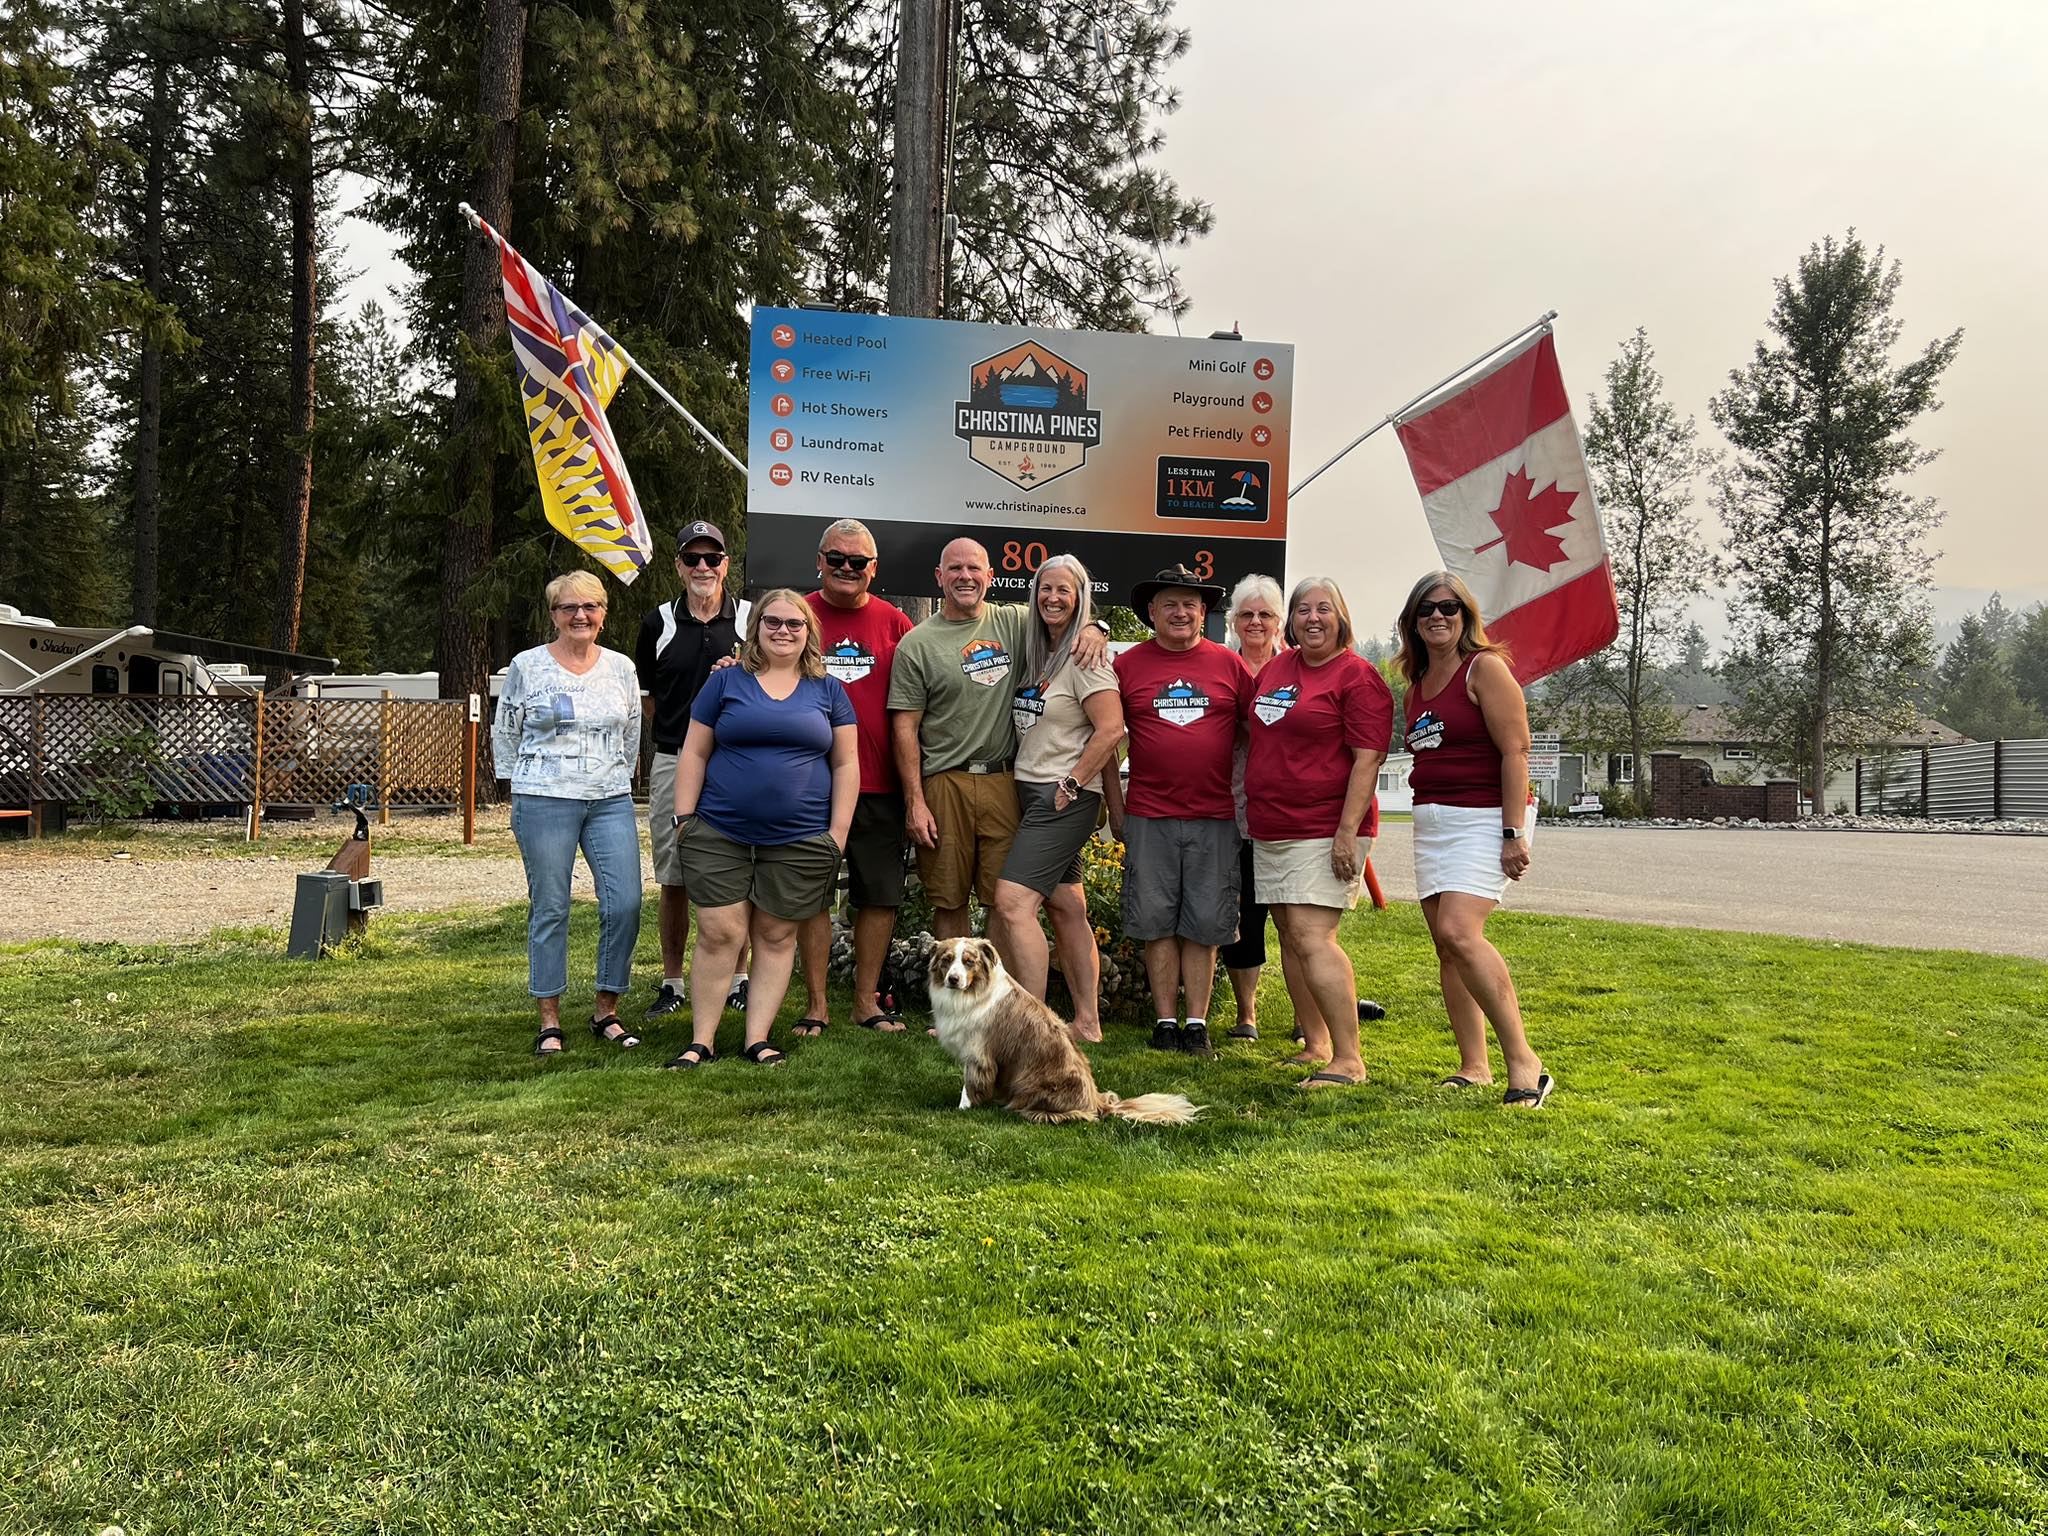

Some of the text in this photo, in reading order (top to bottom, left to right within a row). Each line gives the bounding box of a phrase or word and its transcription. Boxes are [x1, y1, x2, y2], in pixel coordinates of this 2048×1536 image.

[803, 331, 887, 350] Heated Pool
[1189, 359, 1247, 374] Mini Golf
[802, 367, 871, 383] Free Wi-Fi
[1173, 392, 1245, 408] Playground
[802, 402, 888, 419] Hot Showers
[958, 409, 1097, 438] CHRISTINA PINES
[1168, 425, 1243, 443] Pet Friendly
[801, 435, 884, 453] Laundromat
[989, 440, 1066, 455] CAMPGROUND
[800, 471, 875, 487] RV Rentals
[1168, 467, 1216, 477] LESS THAN
[1167, 479, 1215, 498] 1 KM
[965, 500, 1086, 516] www.christinapines.ca
[1168, 500, 1215, 509] TO BEACH
[1001, 540, 1048, 573] 80
[1194, 550, 1215, 580] 3
[988, 577, 1026, 589] RVICE
[40, 638, 76, 655] Shadow
[820, 655, 875, 665] CHRISTINA PINES
[962, 655, 1011, 673] CHRISTINA PINES
[1153, 697, 1209, 708] CHRISTINA PINES
